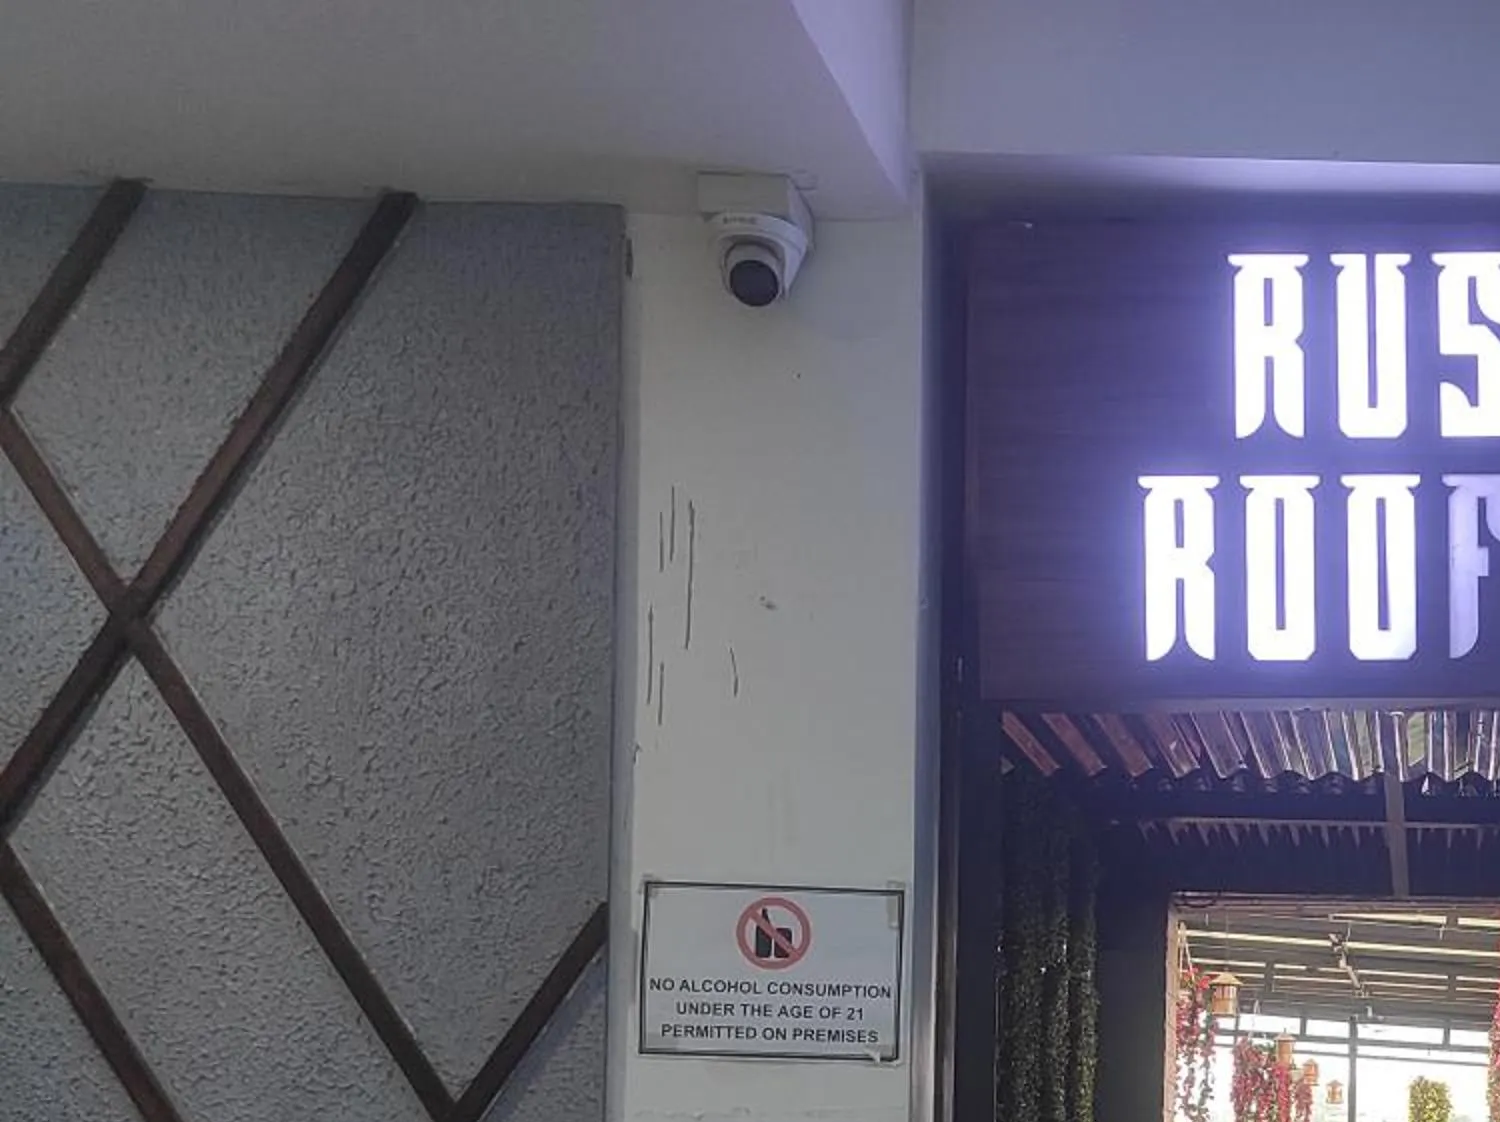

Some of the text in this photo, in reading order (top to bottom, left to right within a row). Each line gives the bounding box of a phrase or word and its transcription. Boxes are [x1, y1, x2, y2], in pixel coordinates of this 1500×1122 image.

[649, 978, 892, 999] NO ALCOHOL CONSUMPTION
[676, 1002, 864, 1021] UNDER THE AGE OF 21
[661, 1024, 879, 1043] PERMITTED ON PREMISES
